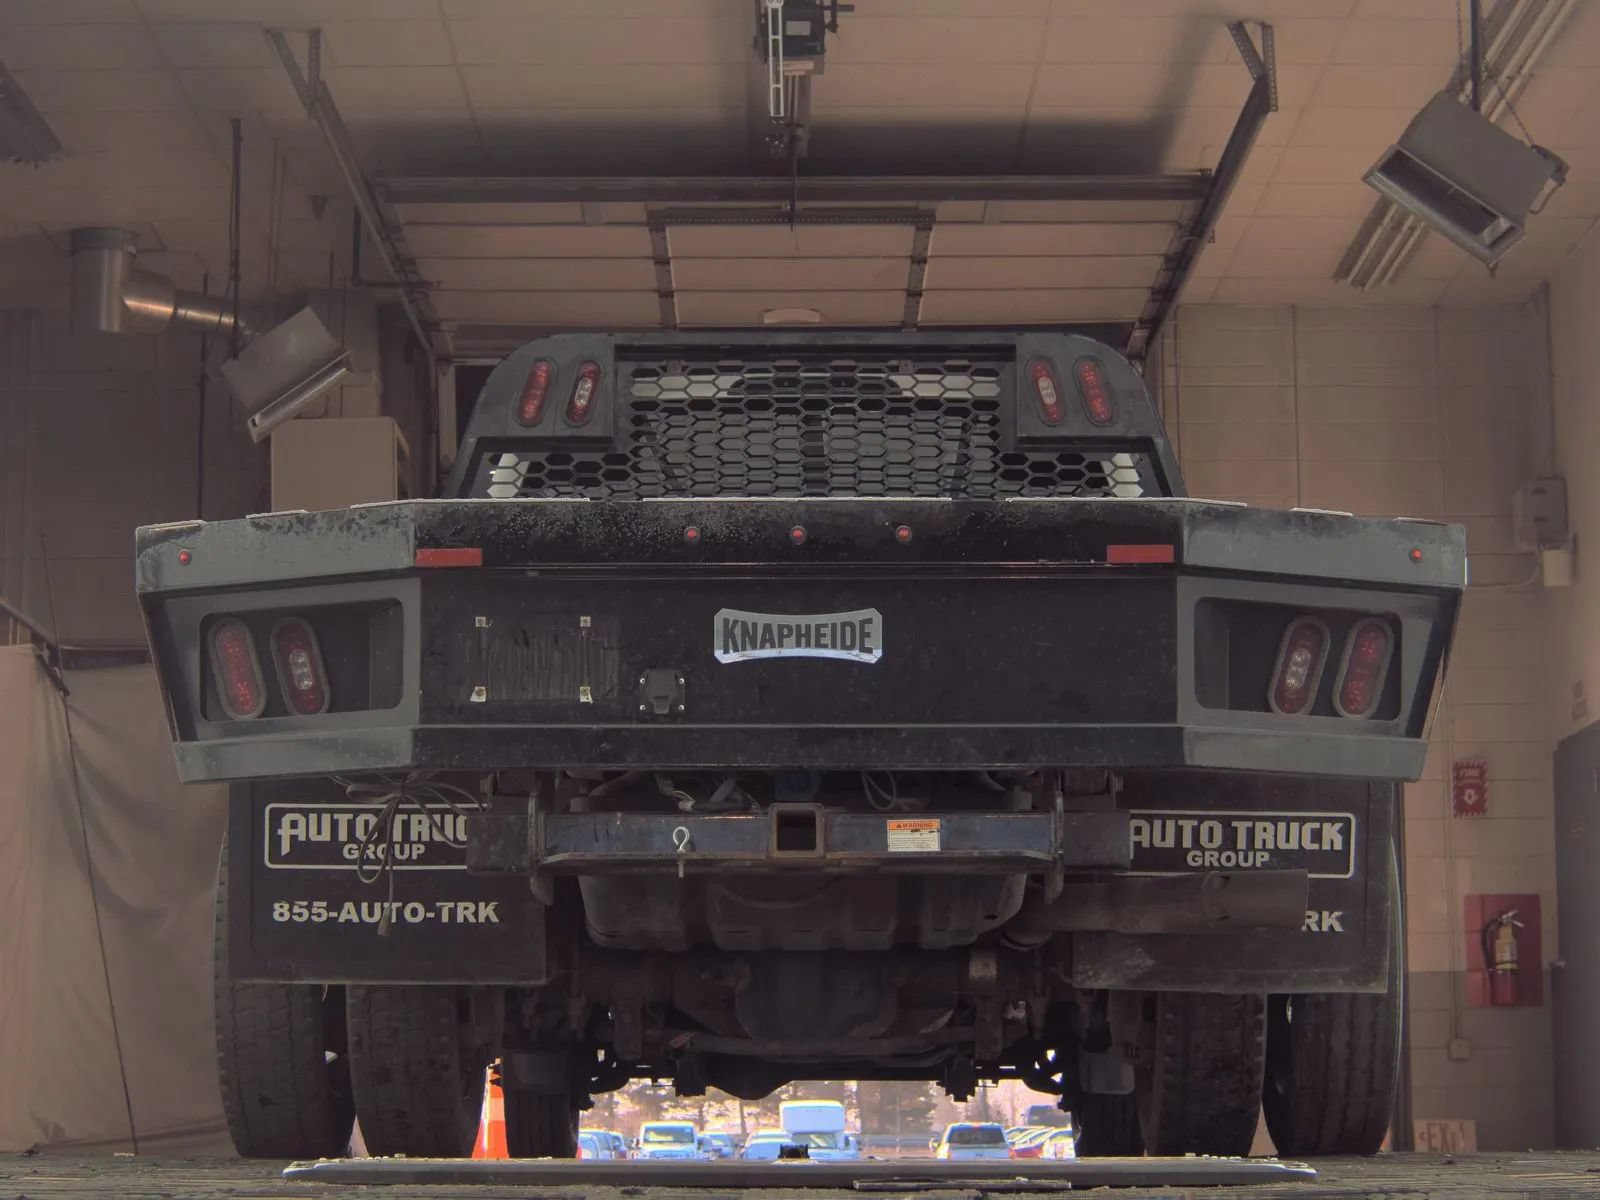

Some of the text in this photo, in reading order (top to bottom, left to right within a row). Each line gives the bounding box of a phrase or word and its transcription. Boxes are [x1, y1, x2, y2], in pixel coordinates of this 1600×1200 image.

[722, 617, 873, 655] KNAPHEIDE
[278, 812, 468, 856] AUTO TRUC
[1130, 818, 1344, 860] AUTO TRUCK
[342, 843, 426, 860] GROUP
[1186, 850, 1270, 868] GROUP
[272, 901, 500, 924] 855-AUTO-TRK
